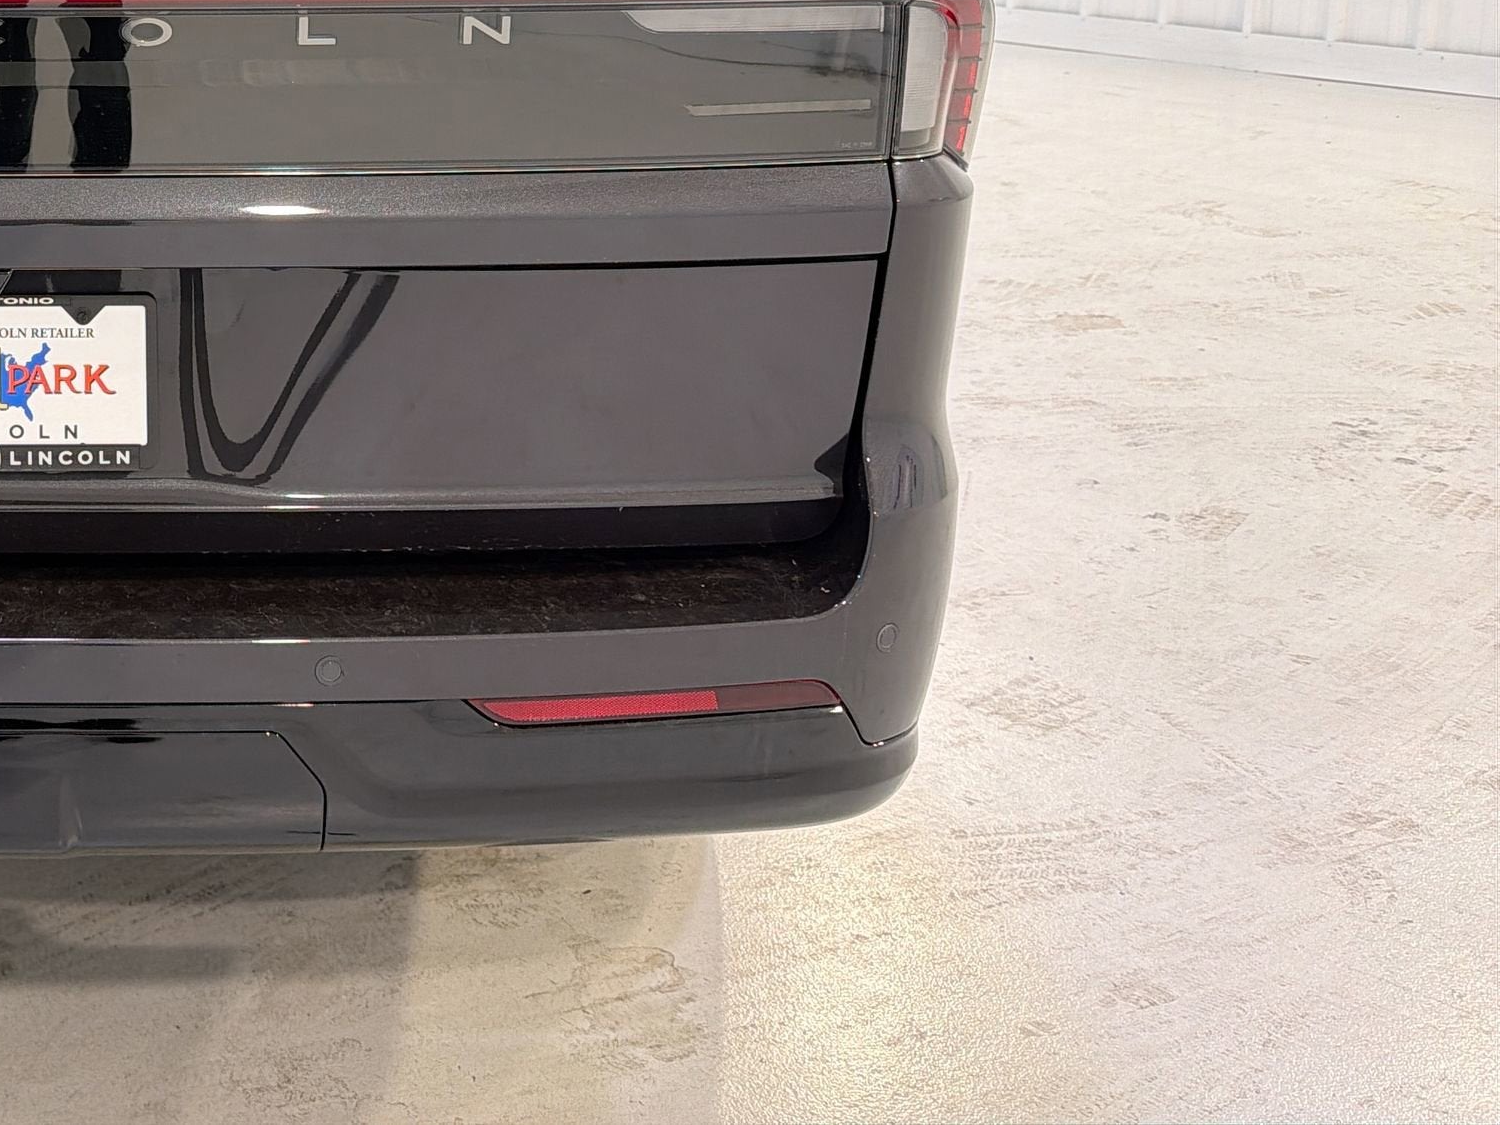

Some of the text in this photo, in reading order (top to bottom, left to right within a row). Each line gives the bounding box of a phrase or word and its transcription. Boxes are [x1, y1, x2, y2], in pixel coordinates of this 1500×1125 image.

[30, 327, 95, 339] RETAILER
[6, 363, 117, 395] PARK
[8, 450, 131, 466] LINCOLN
